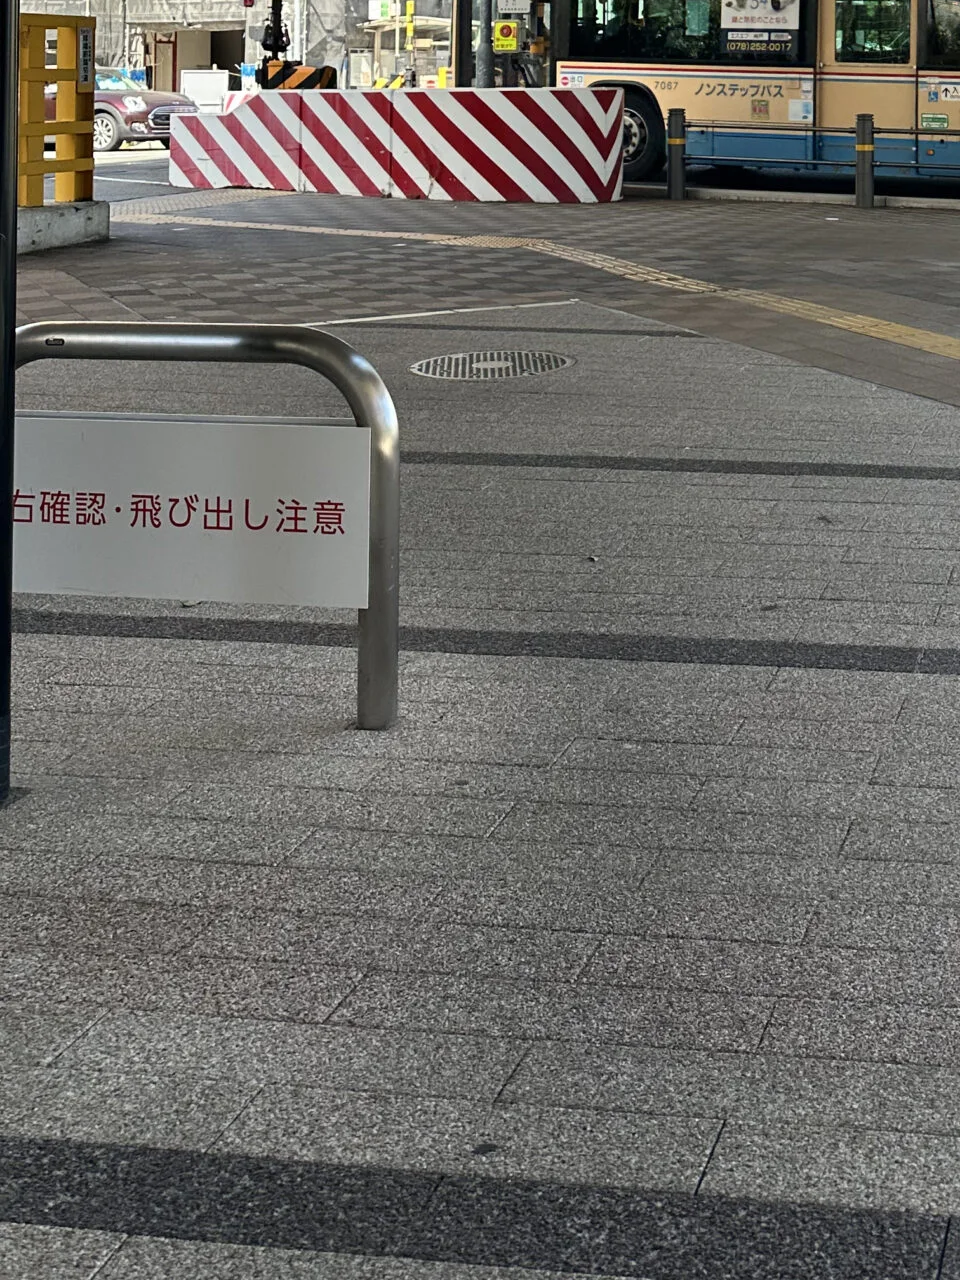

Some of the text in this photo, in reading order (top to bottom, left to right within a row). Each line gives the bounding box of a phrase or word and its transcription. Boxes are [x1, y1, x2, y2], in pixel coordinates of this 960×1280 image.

[726, 42, 792, 51] (078)252-0017
[654, 81, 679, 90] 7067
[694, 83, 784, 98] ノンステップバス
